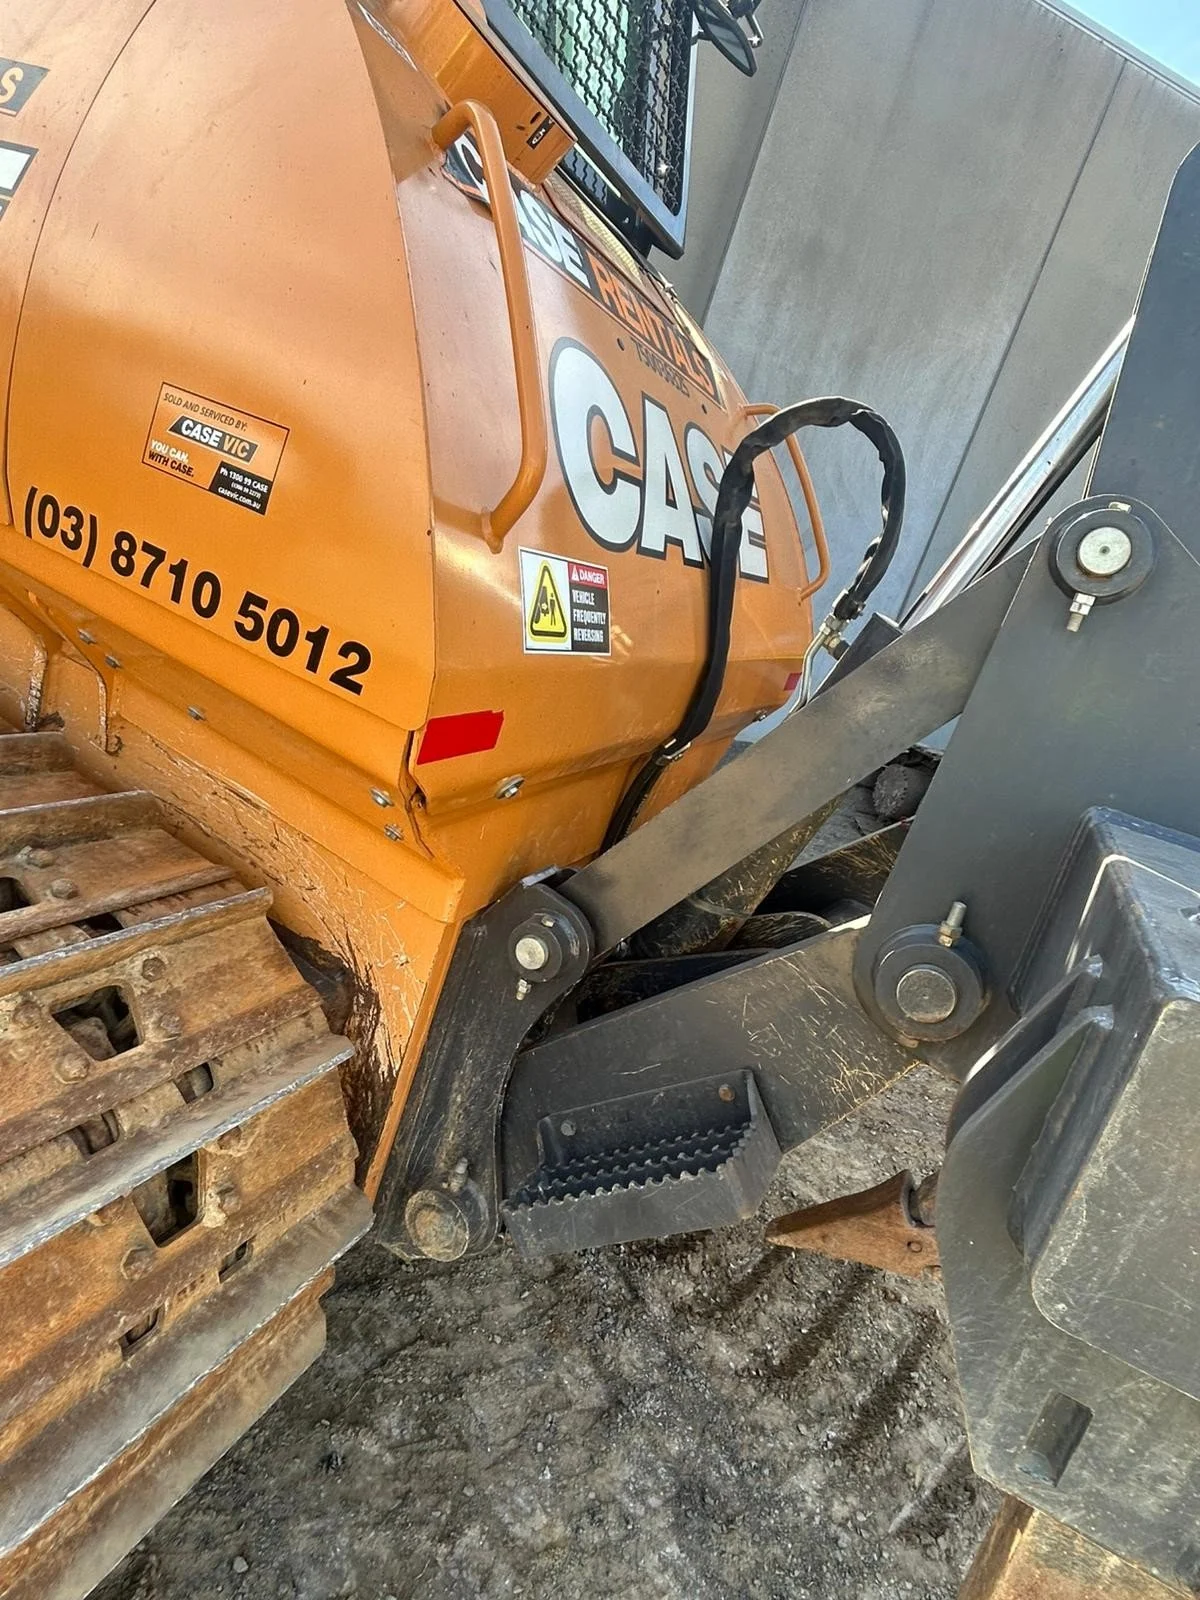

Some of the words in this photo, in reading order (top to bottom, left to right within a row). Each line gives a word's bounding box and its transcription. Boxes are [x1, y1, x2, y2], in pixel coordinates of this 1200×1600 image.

[586, 250, 716, 397] RENTALS
[163, 392, 182, 406] SOLD
[183, 401, 200, 413] AND
[199, 407, 235, 426] SERVICED
[235, 419, 248, 432] BY:
[150, 439, 169, 454] YOU
[181, 419, 223, 447] CASE
[223, 435, 250, 458] VIC
[149, 451, 170, 467] WITH
[170, 459, 194, 477] CASE.
[219, 467, 229, 476] Ph
[229, 471, 243, 482] 1300
[243, 477, 252, 486] 99
[252, 480, 269, 493] CASE
[218, 486, 262, 509] casevic.com.au
[579, 568, 605, 585] DANGER
[24, 485, 98, 569] (03)
[110, 530, 222, 619] 8710
[234, 590, 372, 696] 5012
[571, 589, 595, 605] VEHICLE
[572, 608, 607, 626] FREQUENTLY
[573, 628, 604, 643] REVERSING
